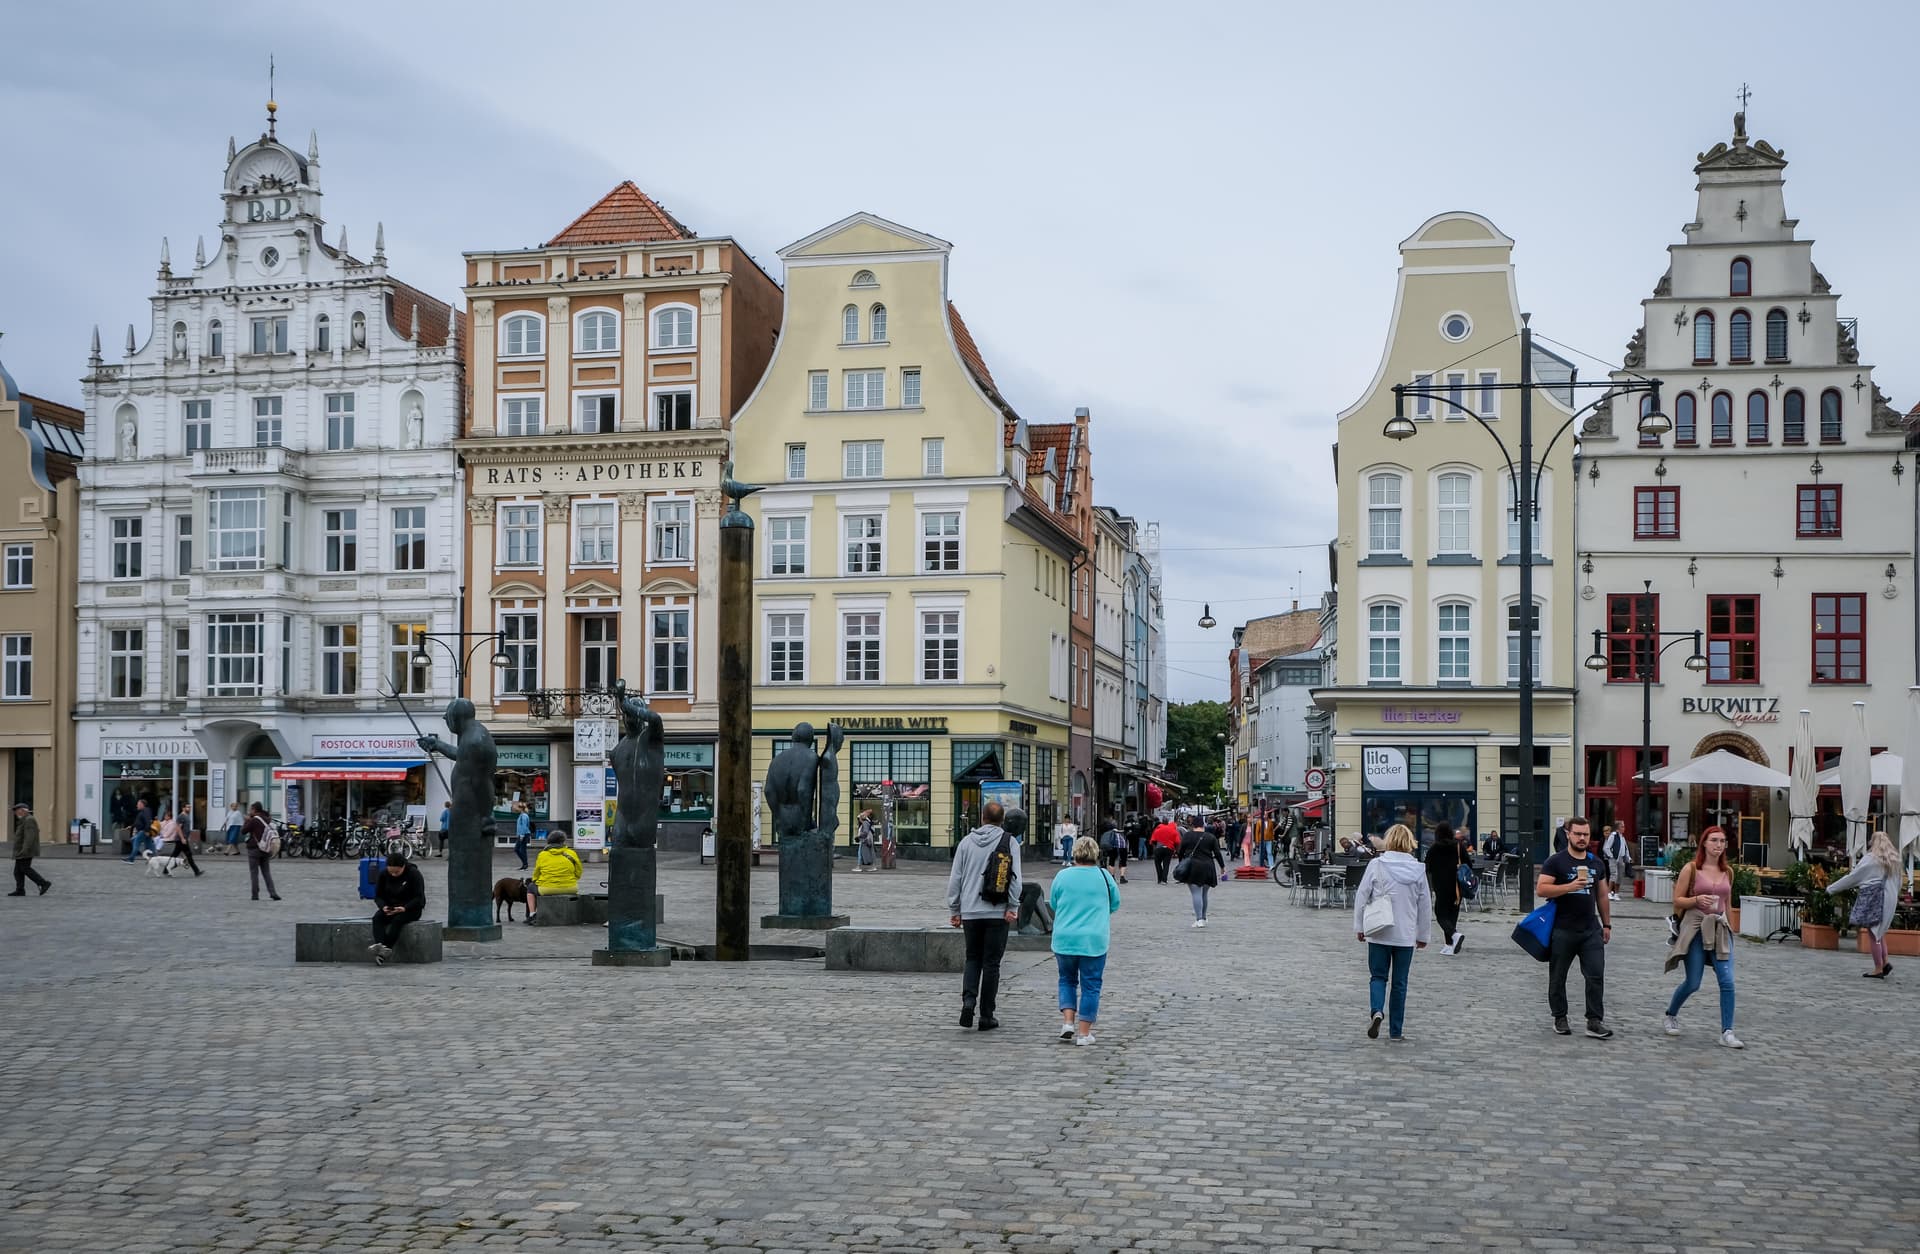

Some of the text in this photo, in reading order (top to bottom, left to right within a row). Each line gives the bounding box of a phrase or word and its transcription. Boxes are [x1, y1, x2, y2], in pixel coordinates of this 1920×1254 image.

[487, 461, 702, 484] RATS APOTHEKE
[1682, 698, 1780, 721] BURWITZ
[830, 717, 948, 729] JUWELIER WITT
[320, 740, 416, 749] ROSTOCK TOURISTIK
[664, 751, 692, 760] THEKE
[1367, 751, 1389, 764] lila
